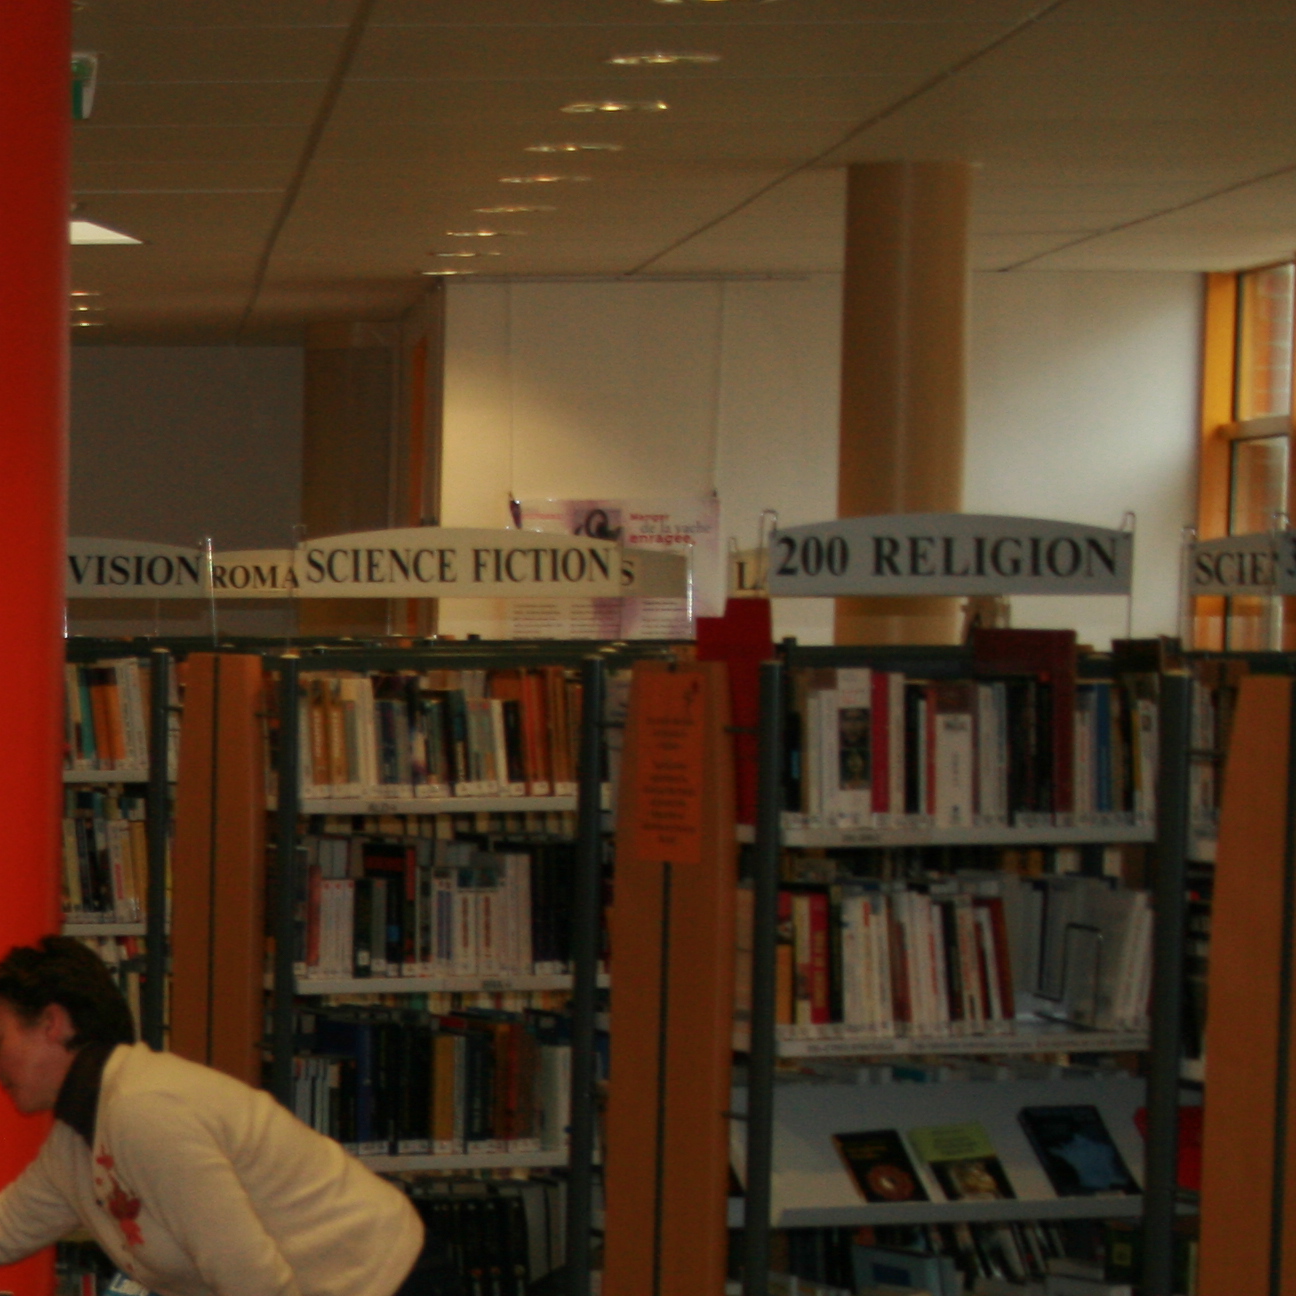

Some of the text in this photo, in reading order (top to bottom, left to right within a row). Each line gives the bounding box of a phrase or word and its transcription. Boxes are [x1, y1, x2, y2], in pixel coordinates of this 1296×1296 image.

[307, 546, 612, 584] SCIENCE FICTION
[775, 536, 1119, 578] 200 RELIGION
